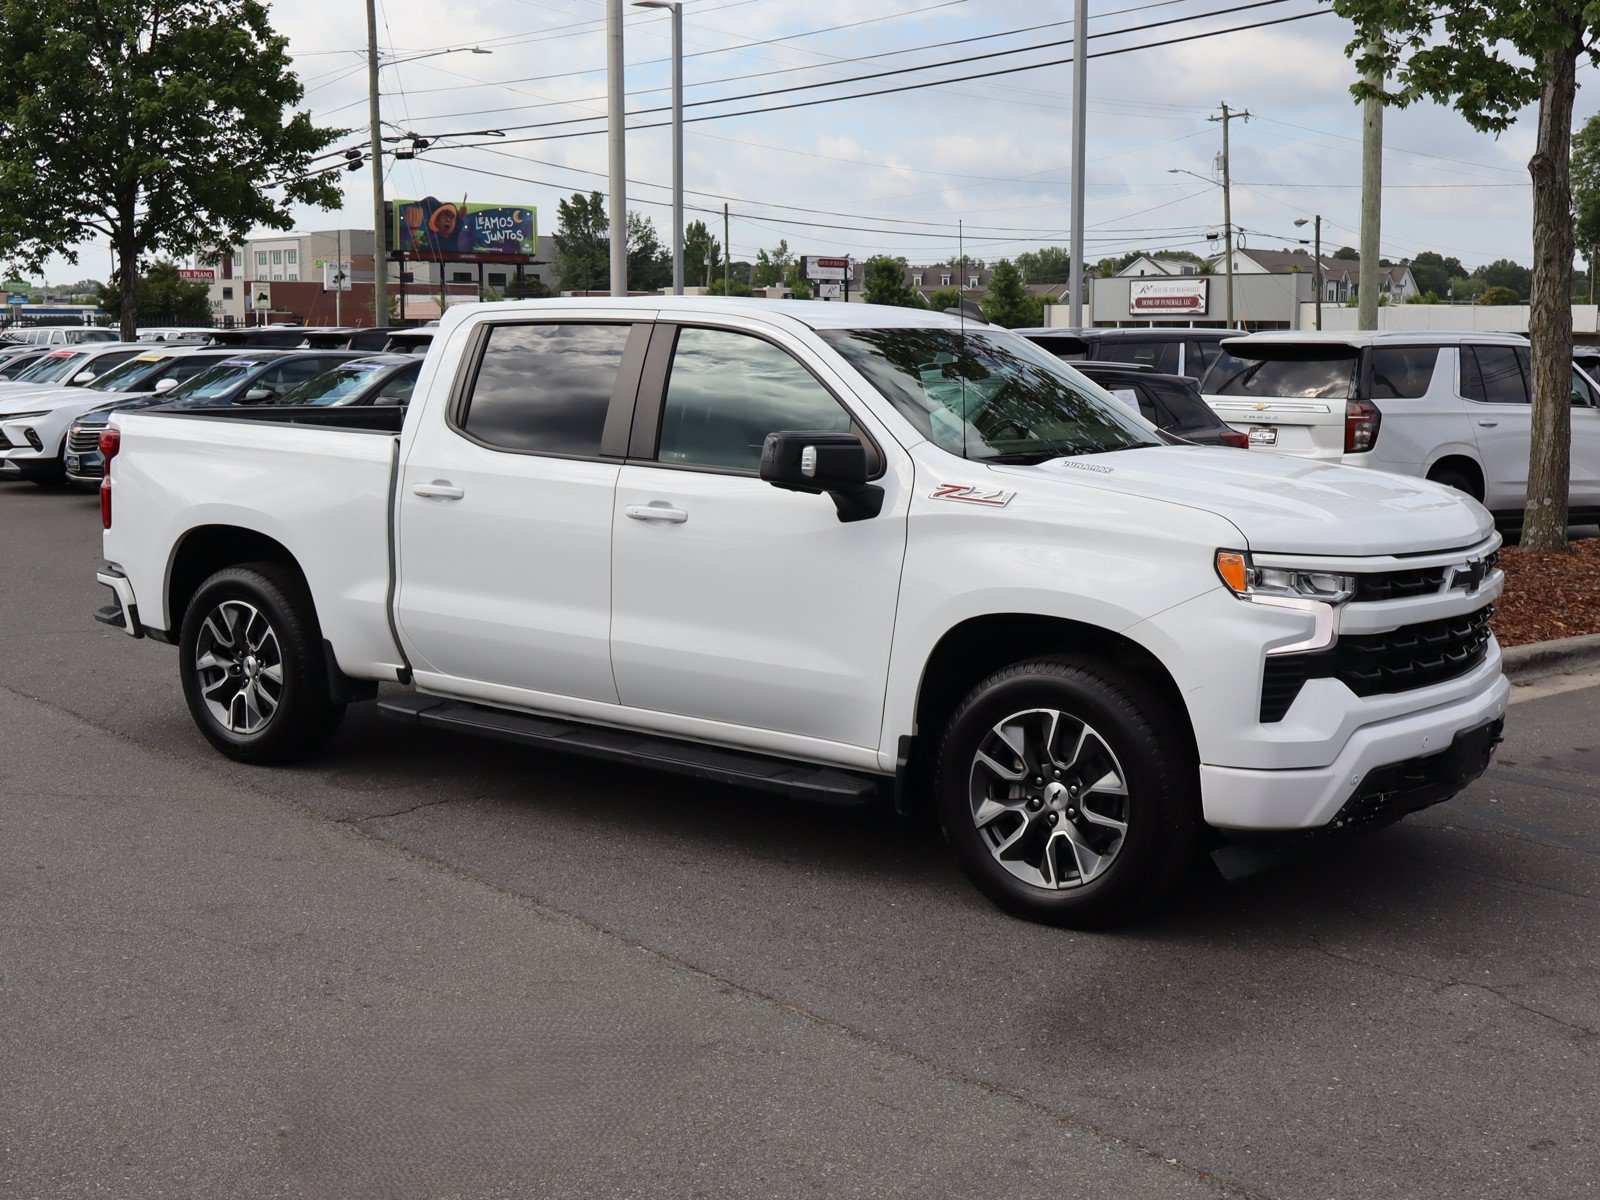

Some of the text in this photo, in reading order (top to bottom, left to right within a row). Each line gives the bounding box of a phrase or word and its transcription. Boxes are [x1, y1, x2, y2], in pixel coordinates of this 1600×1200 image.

[475, 216, 514, 230] LEAMOS
[482, 230, 524, 244] JUNTOS
[929, 483, 1016, 507] Z71
